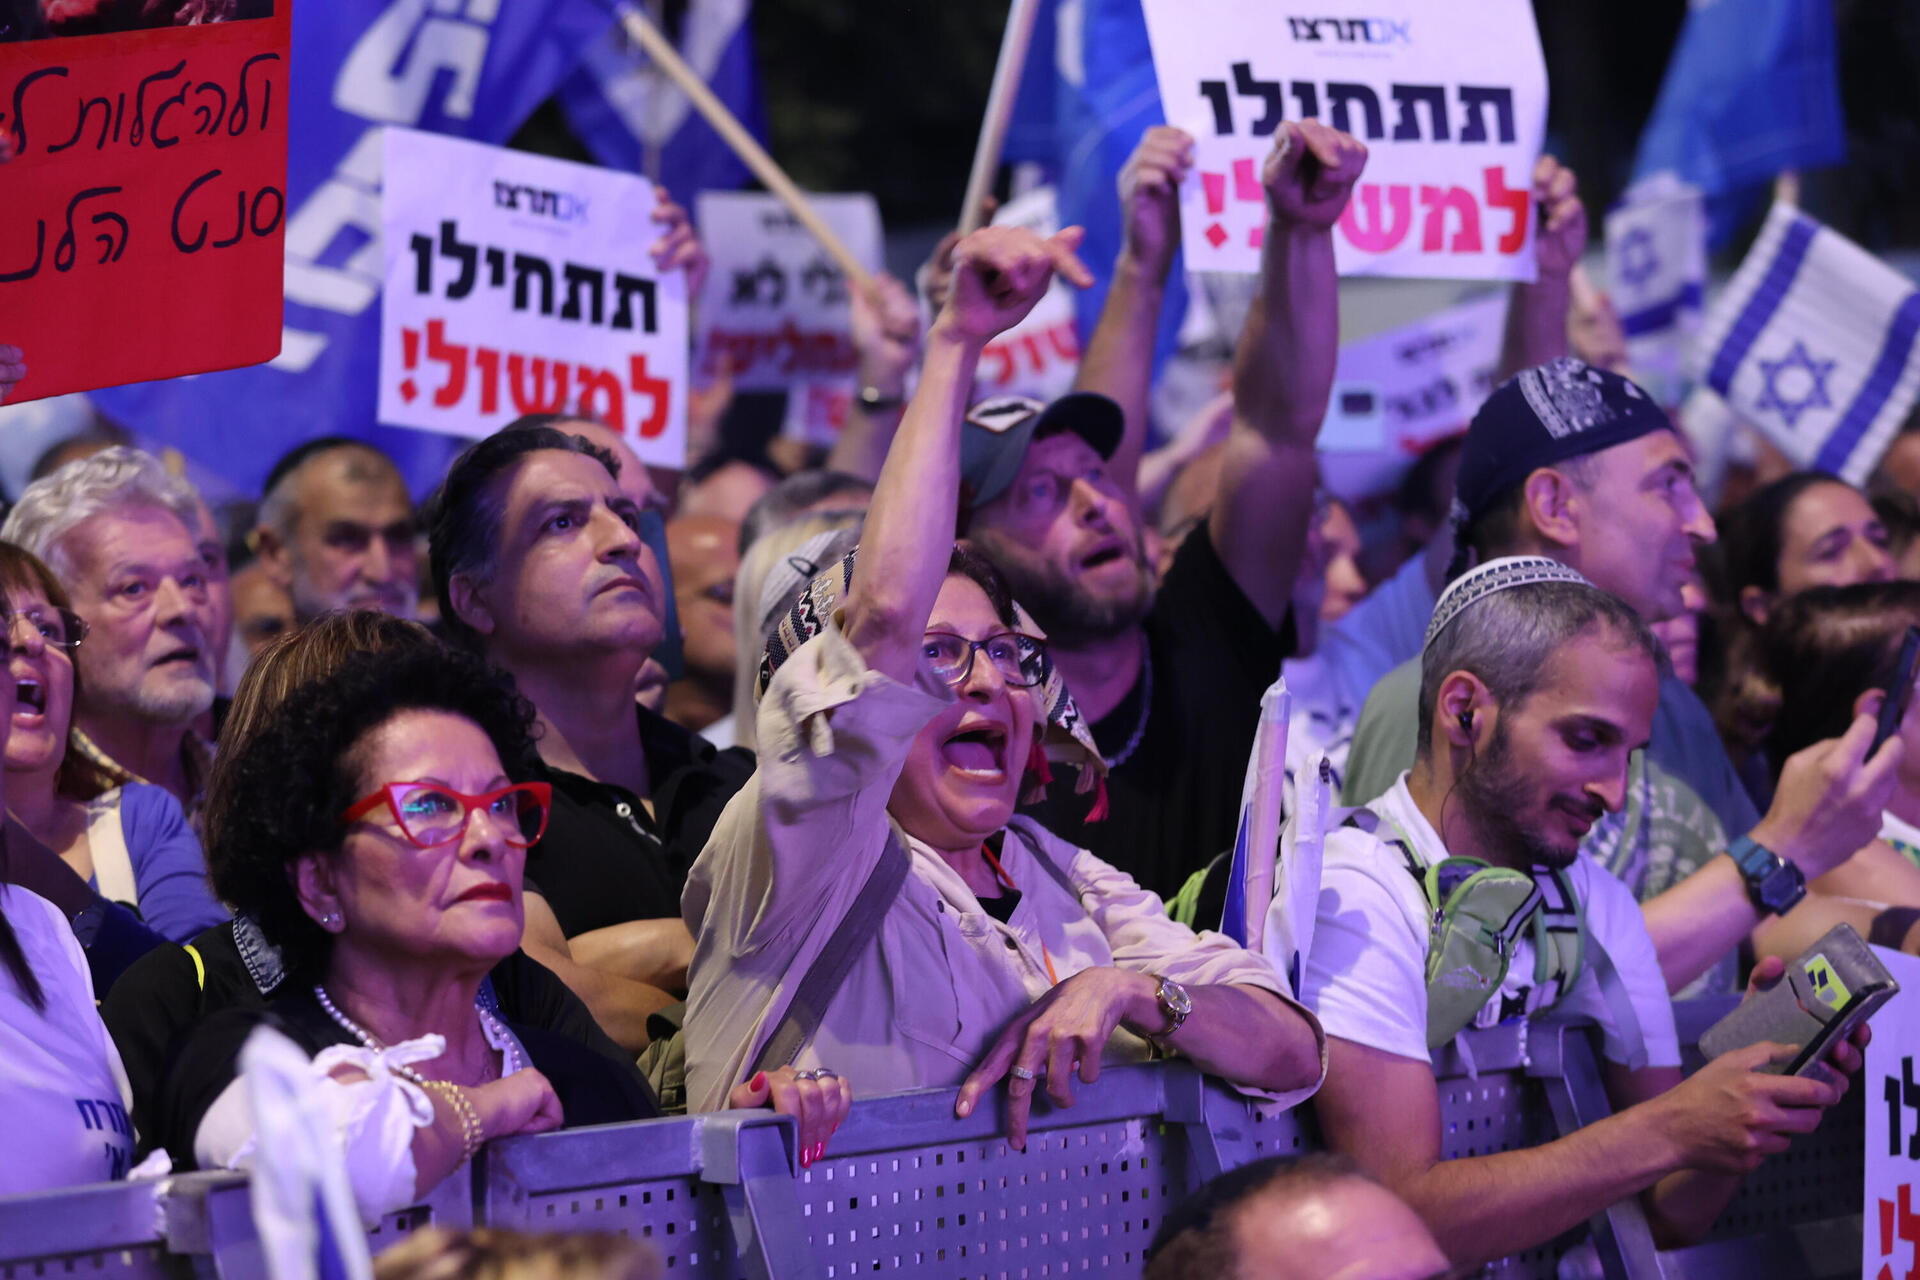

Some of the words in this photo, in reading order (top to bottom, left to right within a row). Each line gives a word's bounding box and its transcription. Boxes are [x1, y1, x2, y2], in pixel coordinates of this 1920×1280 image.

[47, 53, 280, 153] ולהגלות
[1199, 62, 1516, 143] תתחילו
[171, 169, 283, 253] סנט
[1200, 158, 1531, 254] למשל!
[410, 220, 659, 334] תתחילו
[399, 317, 671, 441] למשול!
